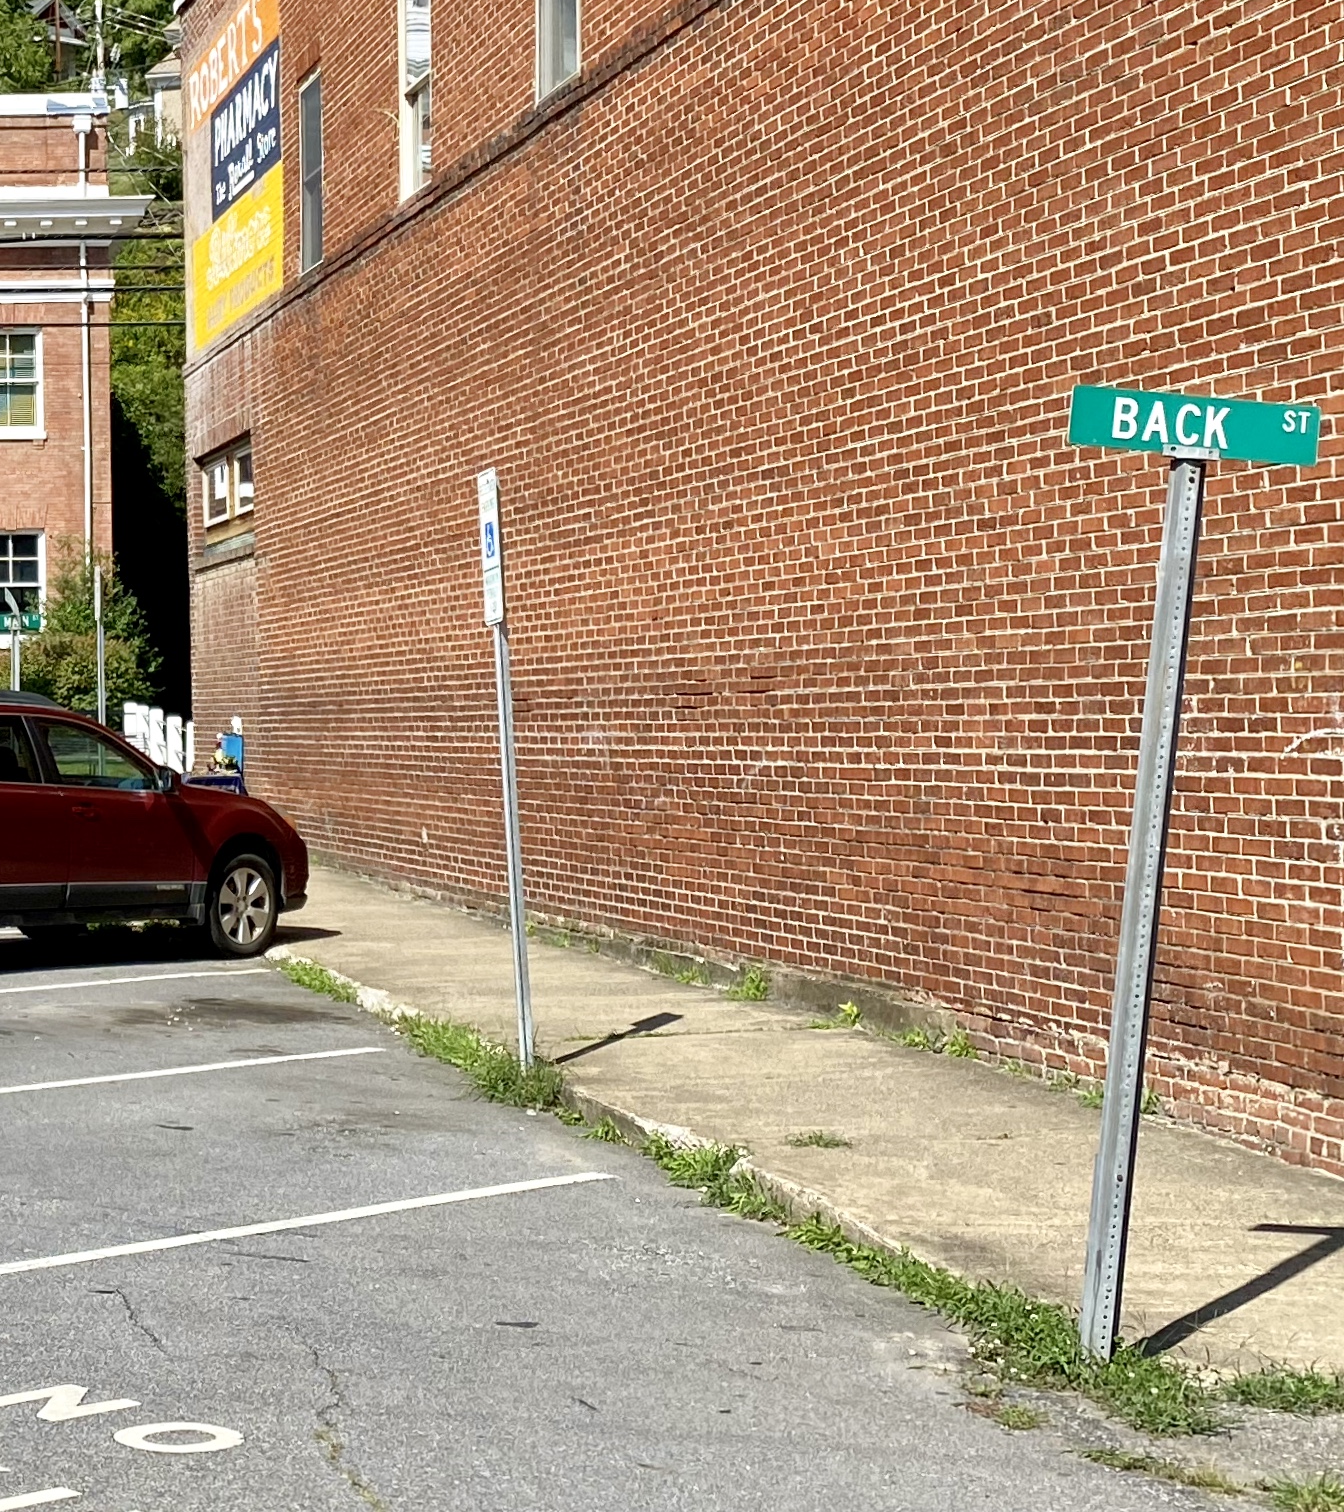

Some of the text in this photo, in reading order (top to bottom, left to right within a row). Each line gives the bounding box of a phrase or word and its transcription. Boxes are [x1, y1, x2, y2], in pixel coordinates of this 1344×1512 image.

[214, 50, 278, 167] PHARMACY
[256, 126, 277, 164] Store
[1111, 396, 1312, 450] BACK ST
[4, 616, 30, 628] MAN
